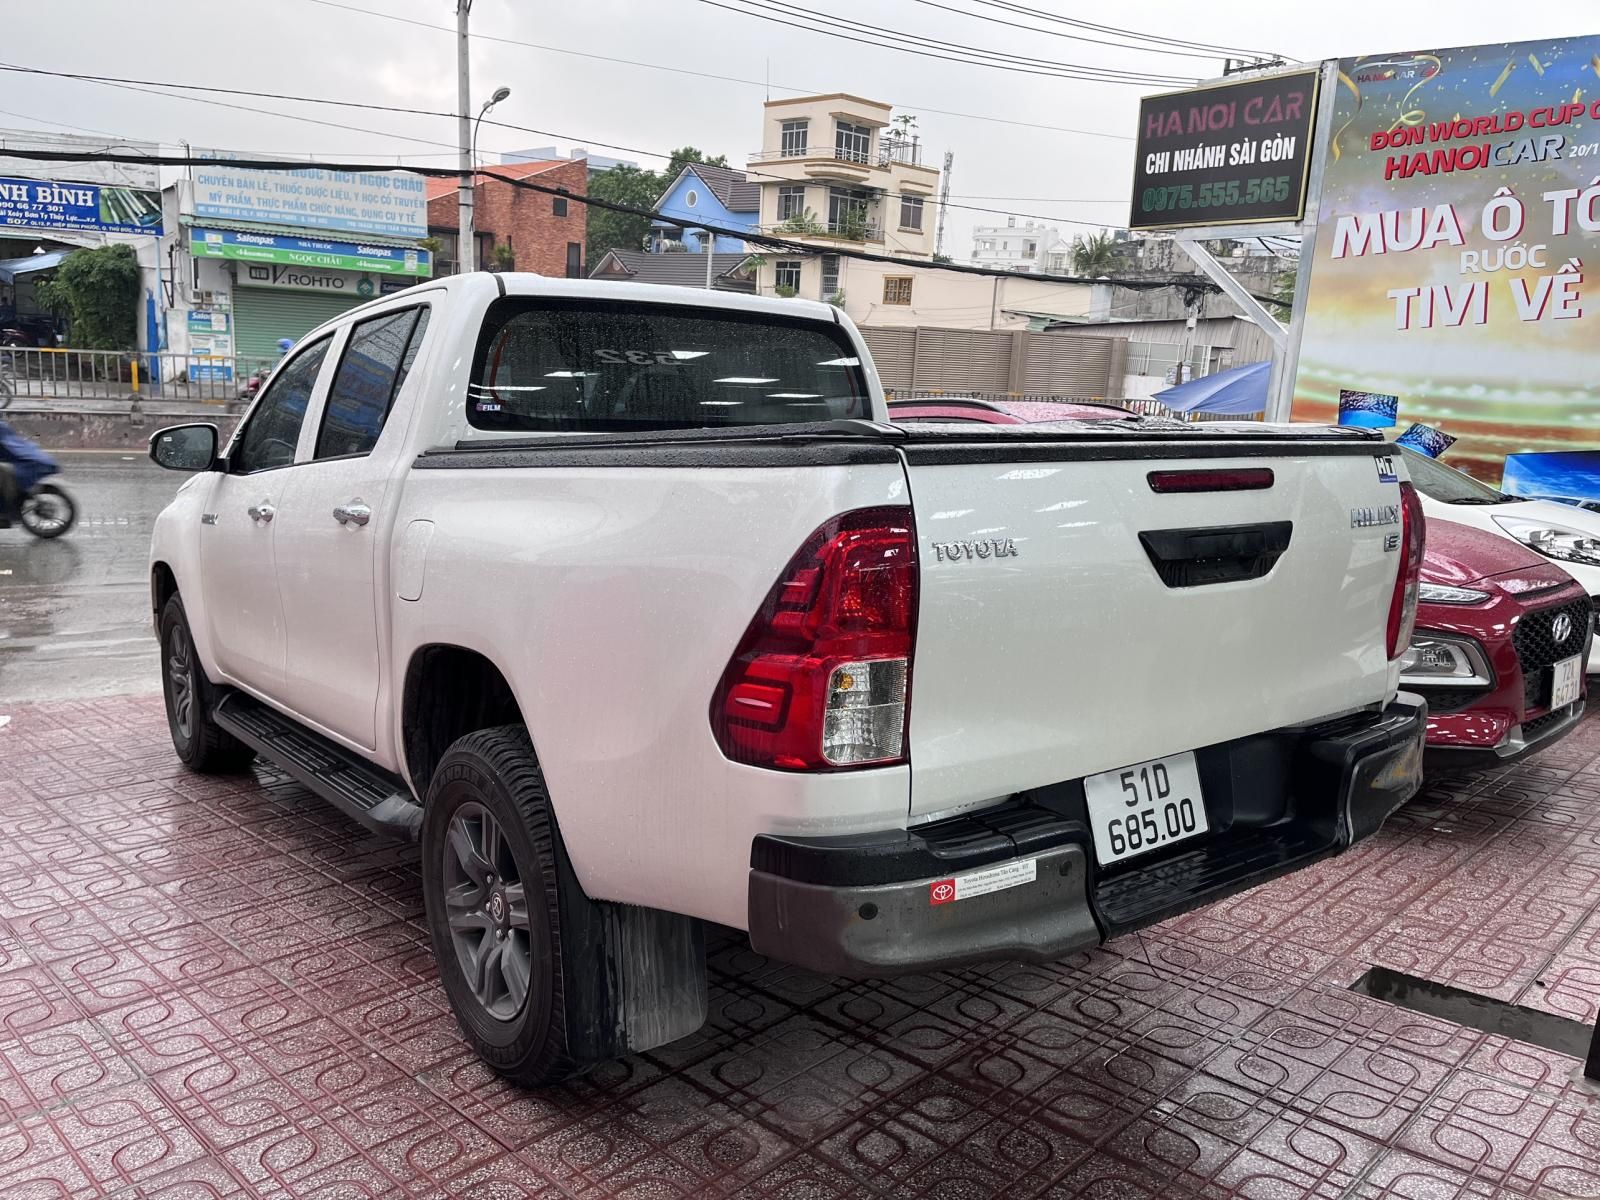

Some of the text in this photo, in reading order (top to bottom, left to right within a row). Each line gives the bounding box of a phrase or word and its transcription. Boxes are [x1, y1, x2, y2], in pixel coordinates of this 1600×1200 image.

[1244, 92, 1304, 125] CAR
[1370, 124, 1425, 150] ĐÓN
[1428, 115, 1524, 142] WORLD
[1528, 103, 1585, 128] CUP
[1145, 133, 1296, 174] CHI NHÁNH SÀI GÒN
[36, 183, 94, 207] BÌNH
[198, 174, 235, 188] CHUYÊN
[360, 174, 390, 188] NGỌC
[1142, 176, 1290, 212] 0975.555.565
[46, 205, 64, 213] 301
[1331, 203, 1465, 260] MUA
[1481, 186, 1525, 241] Ô
[236, 233, 274, 245] Salonpas
[357, 245, 392, 257] Salonpas
[1459, 241, 1546, 274] RƯỚC
[1387, 257, 1584, 330] TIVI VỀ
[932, 538, 1018, 561] TOYOTA
[1121, 763, 1171, 807] 51D
[1108, 798, 1196, 856] 685.00
